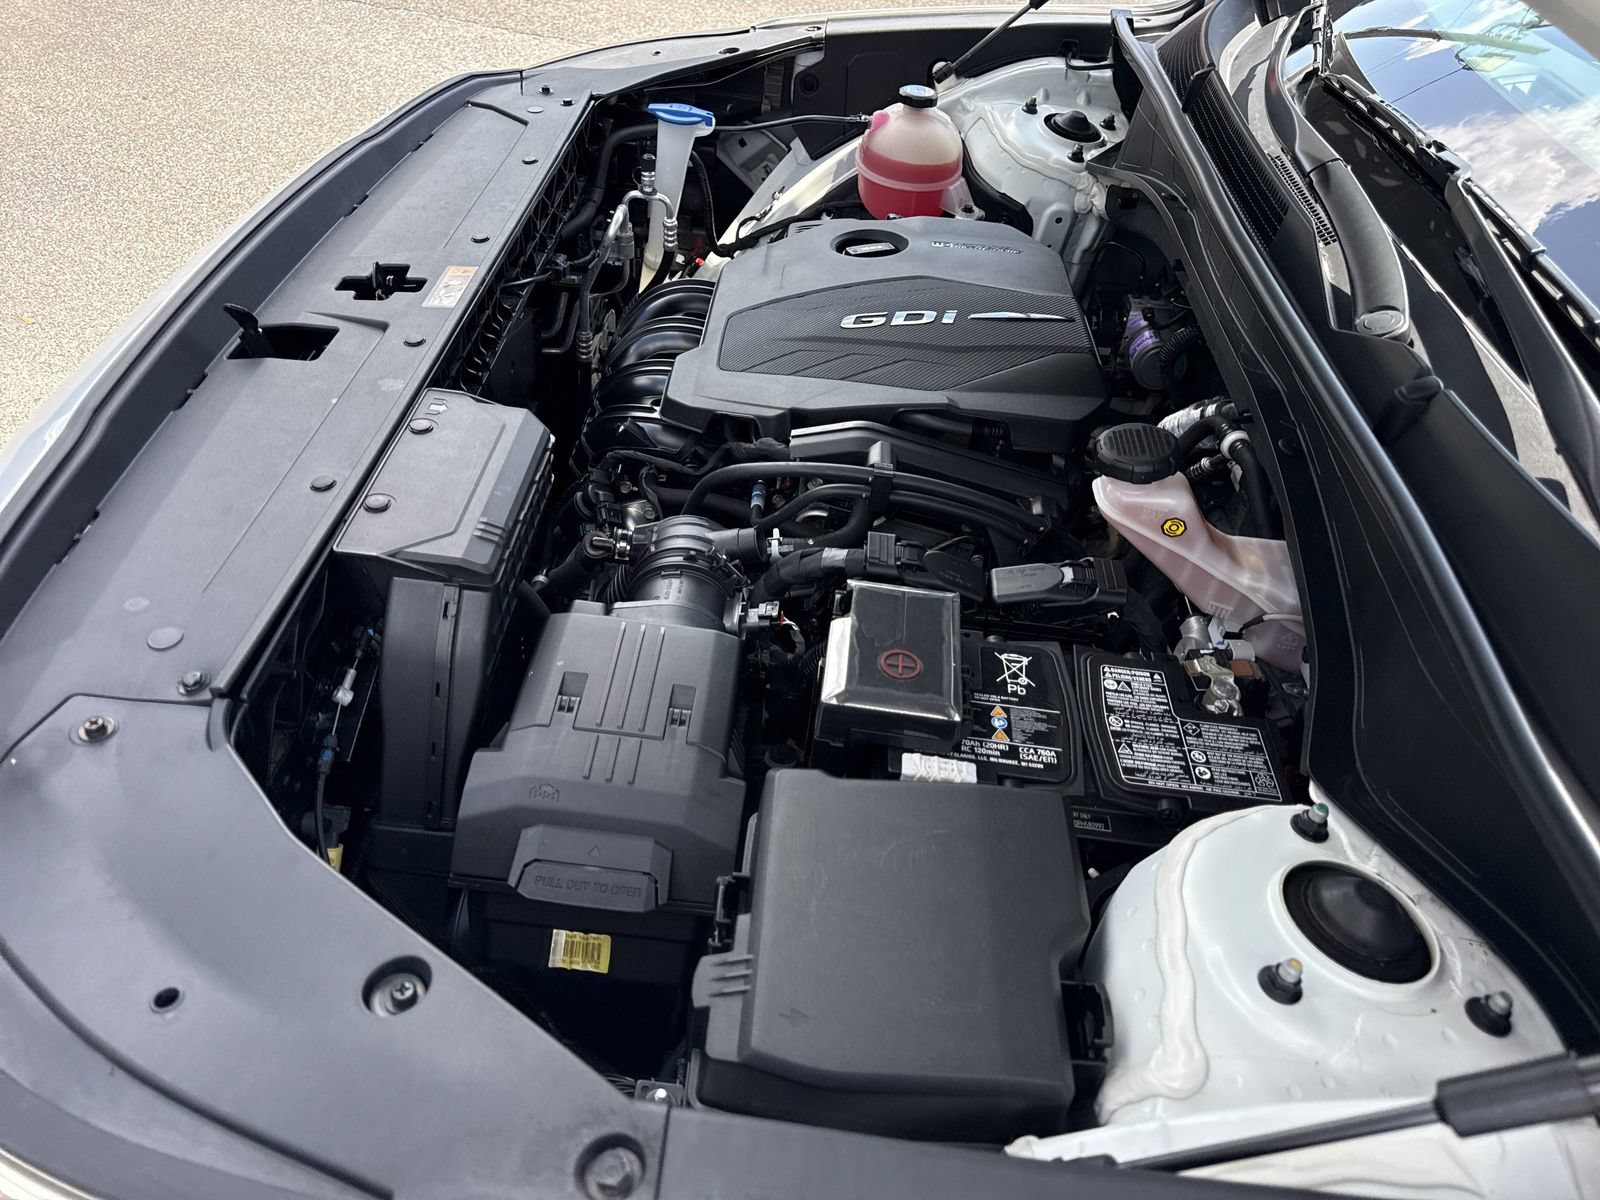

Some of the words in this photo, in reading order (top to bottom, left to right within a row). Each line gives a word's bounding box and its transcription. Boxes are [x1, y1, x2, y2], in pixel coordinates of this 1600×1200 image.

[839, 310, 958, 329] GDi
[1008, 684, 1026, 695] Pb
[974, 747, 1001, 756] 120min
[1019, 746, 1035, 754] CCA
[1037, 749, 1056, 757] 760A
[534, 875, 563, 889] PULL
[566, 879, 591, 891] OUT
[594, 882, 609, 894] TO
[611, 885, 642, 898] OPEN
